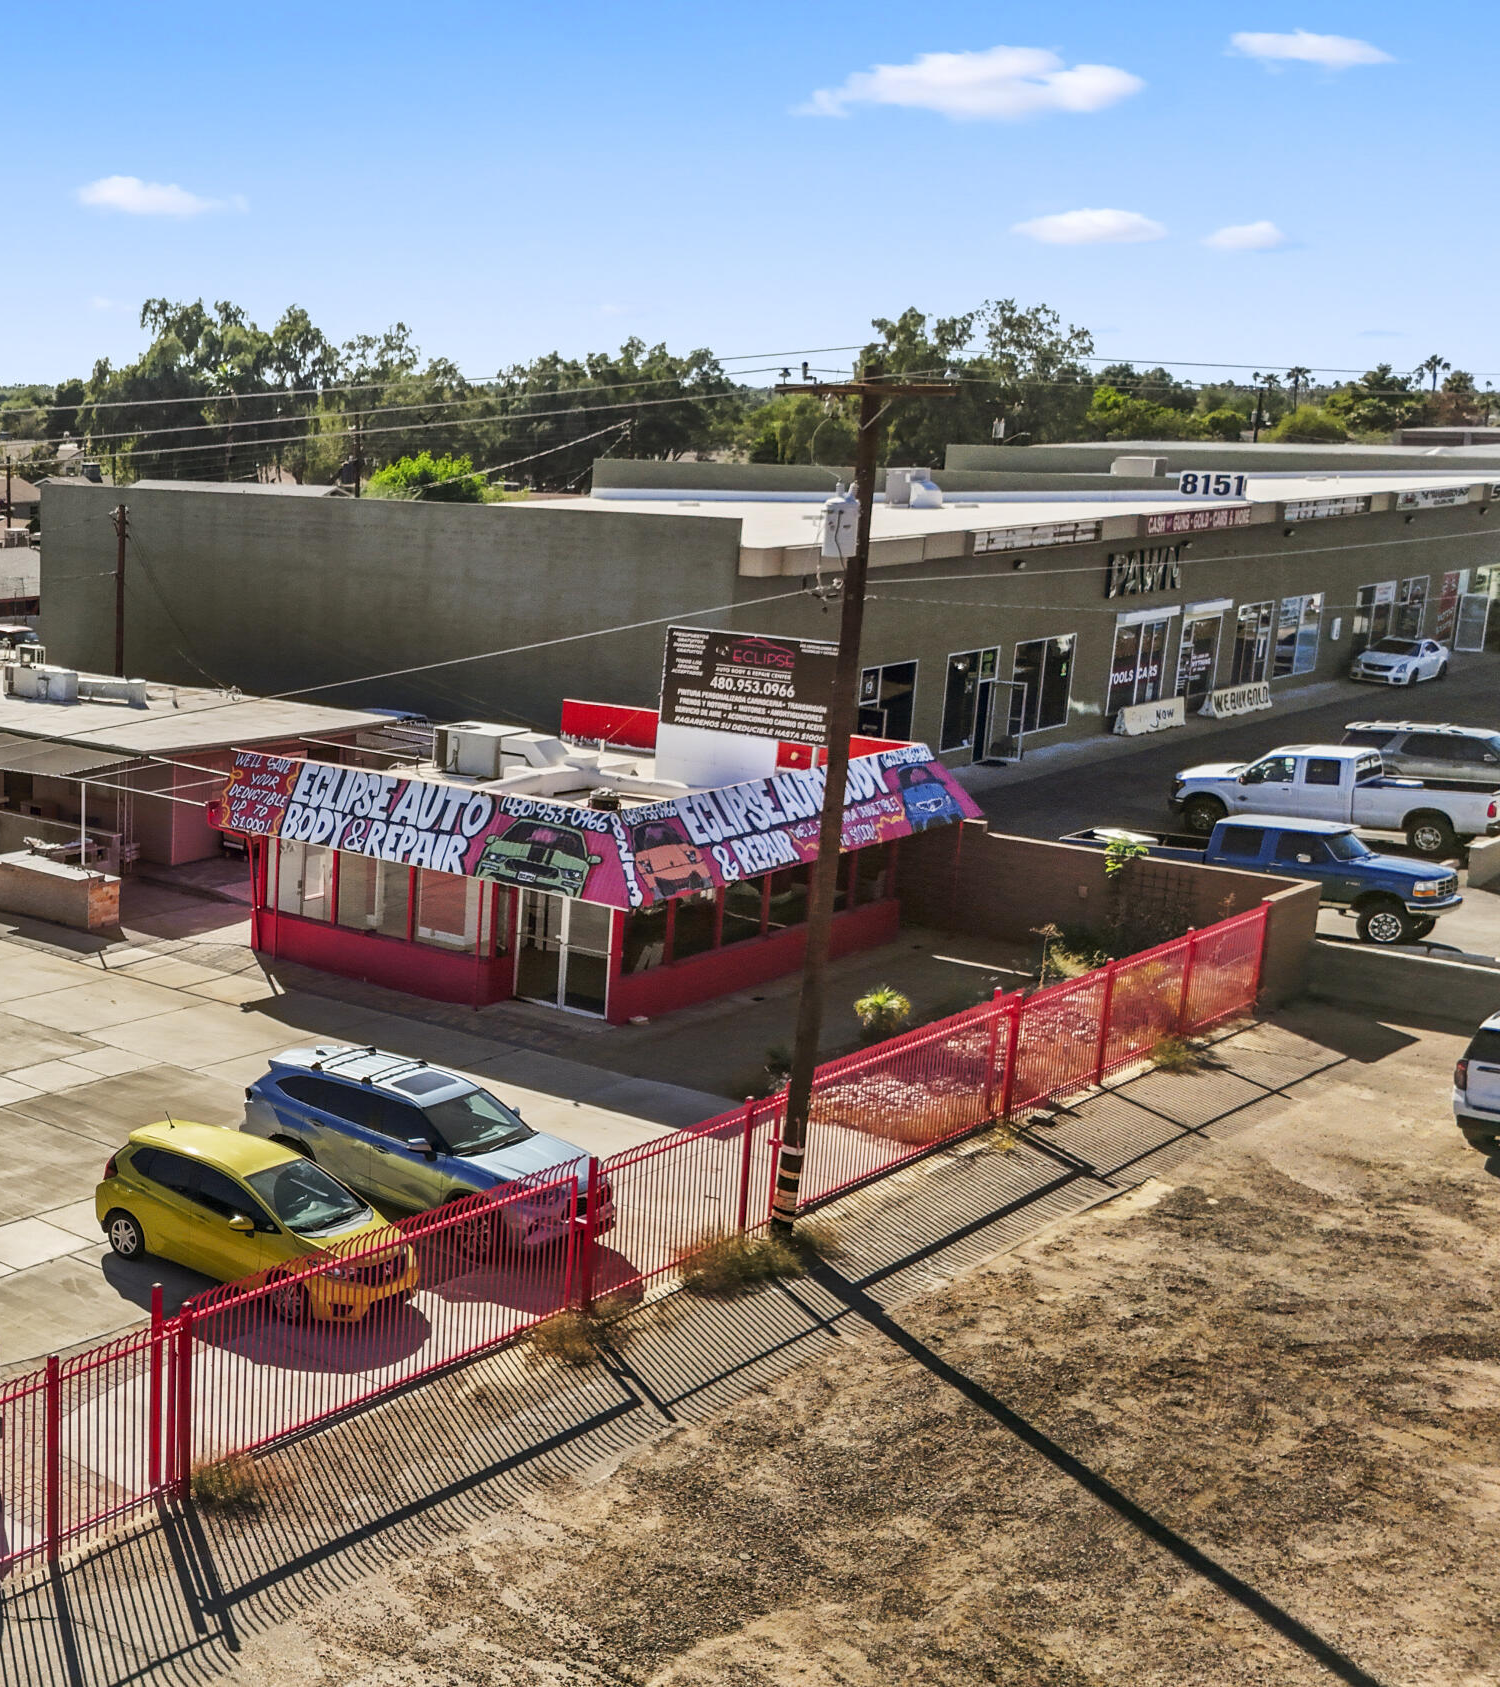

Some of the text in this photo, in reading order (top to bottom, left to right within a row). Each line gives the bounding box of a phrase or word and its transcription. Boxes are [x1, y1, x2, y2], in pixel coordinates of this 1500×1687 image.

[1180, 473, 1245, 496] 8151
[1148, 516, 1166, 534] CASH
[1194, 512, 1209, 529] GOLD
[1106, 547, 1181, 599] PAWN
[732, 649, 796, 669] ECLIPSE
[715, 666, 730, 674] AUTO
[752, 670, 770, 678] REPAIR
[771, 672, 791, 680] CENTER
[1111, 664, 1158, 685] TOOLS CARS
[710, 676, 796, 698] 480.953.0966
[1214, 686, 1269, 713] WE BUY GOLD
[1156, 708, 1174, 720] NOW
[674, 716, 826, 742] PAGAREMOS SU DEDUCIBLE HASTA $1000
[235, 752, 296, 775] WE'LL SAVE
[251, 772, 280, 790] YOUR
[228, 784, 288, 808] DEDUCTIBLE
[291, 762, 493, 838] ECLIPSE AUTO
[675, 779, 787, 846] ECLIPSE
[843, 756, 890, 806] ODY
[231, 800, 268, 818] UP TO
[500, 796, 611, 833] (480)953-0966
[281, 802, 469, 875] BODY & REPAIR
[712, 830, 800, 881] & REPAIR
